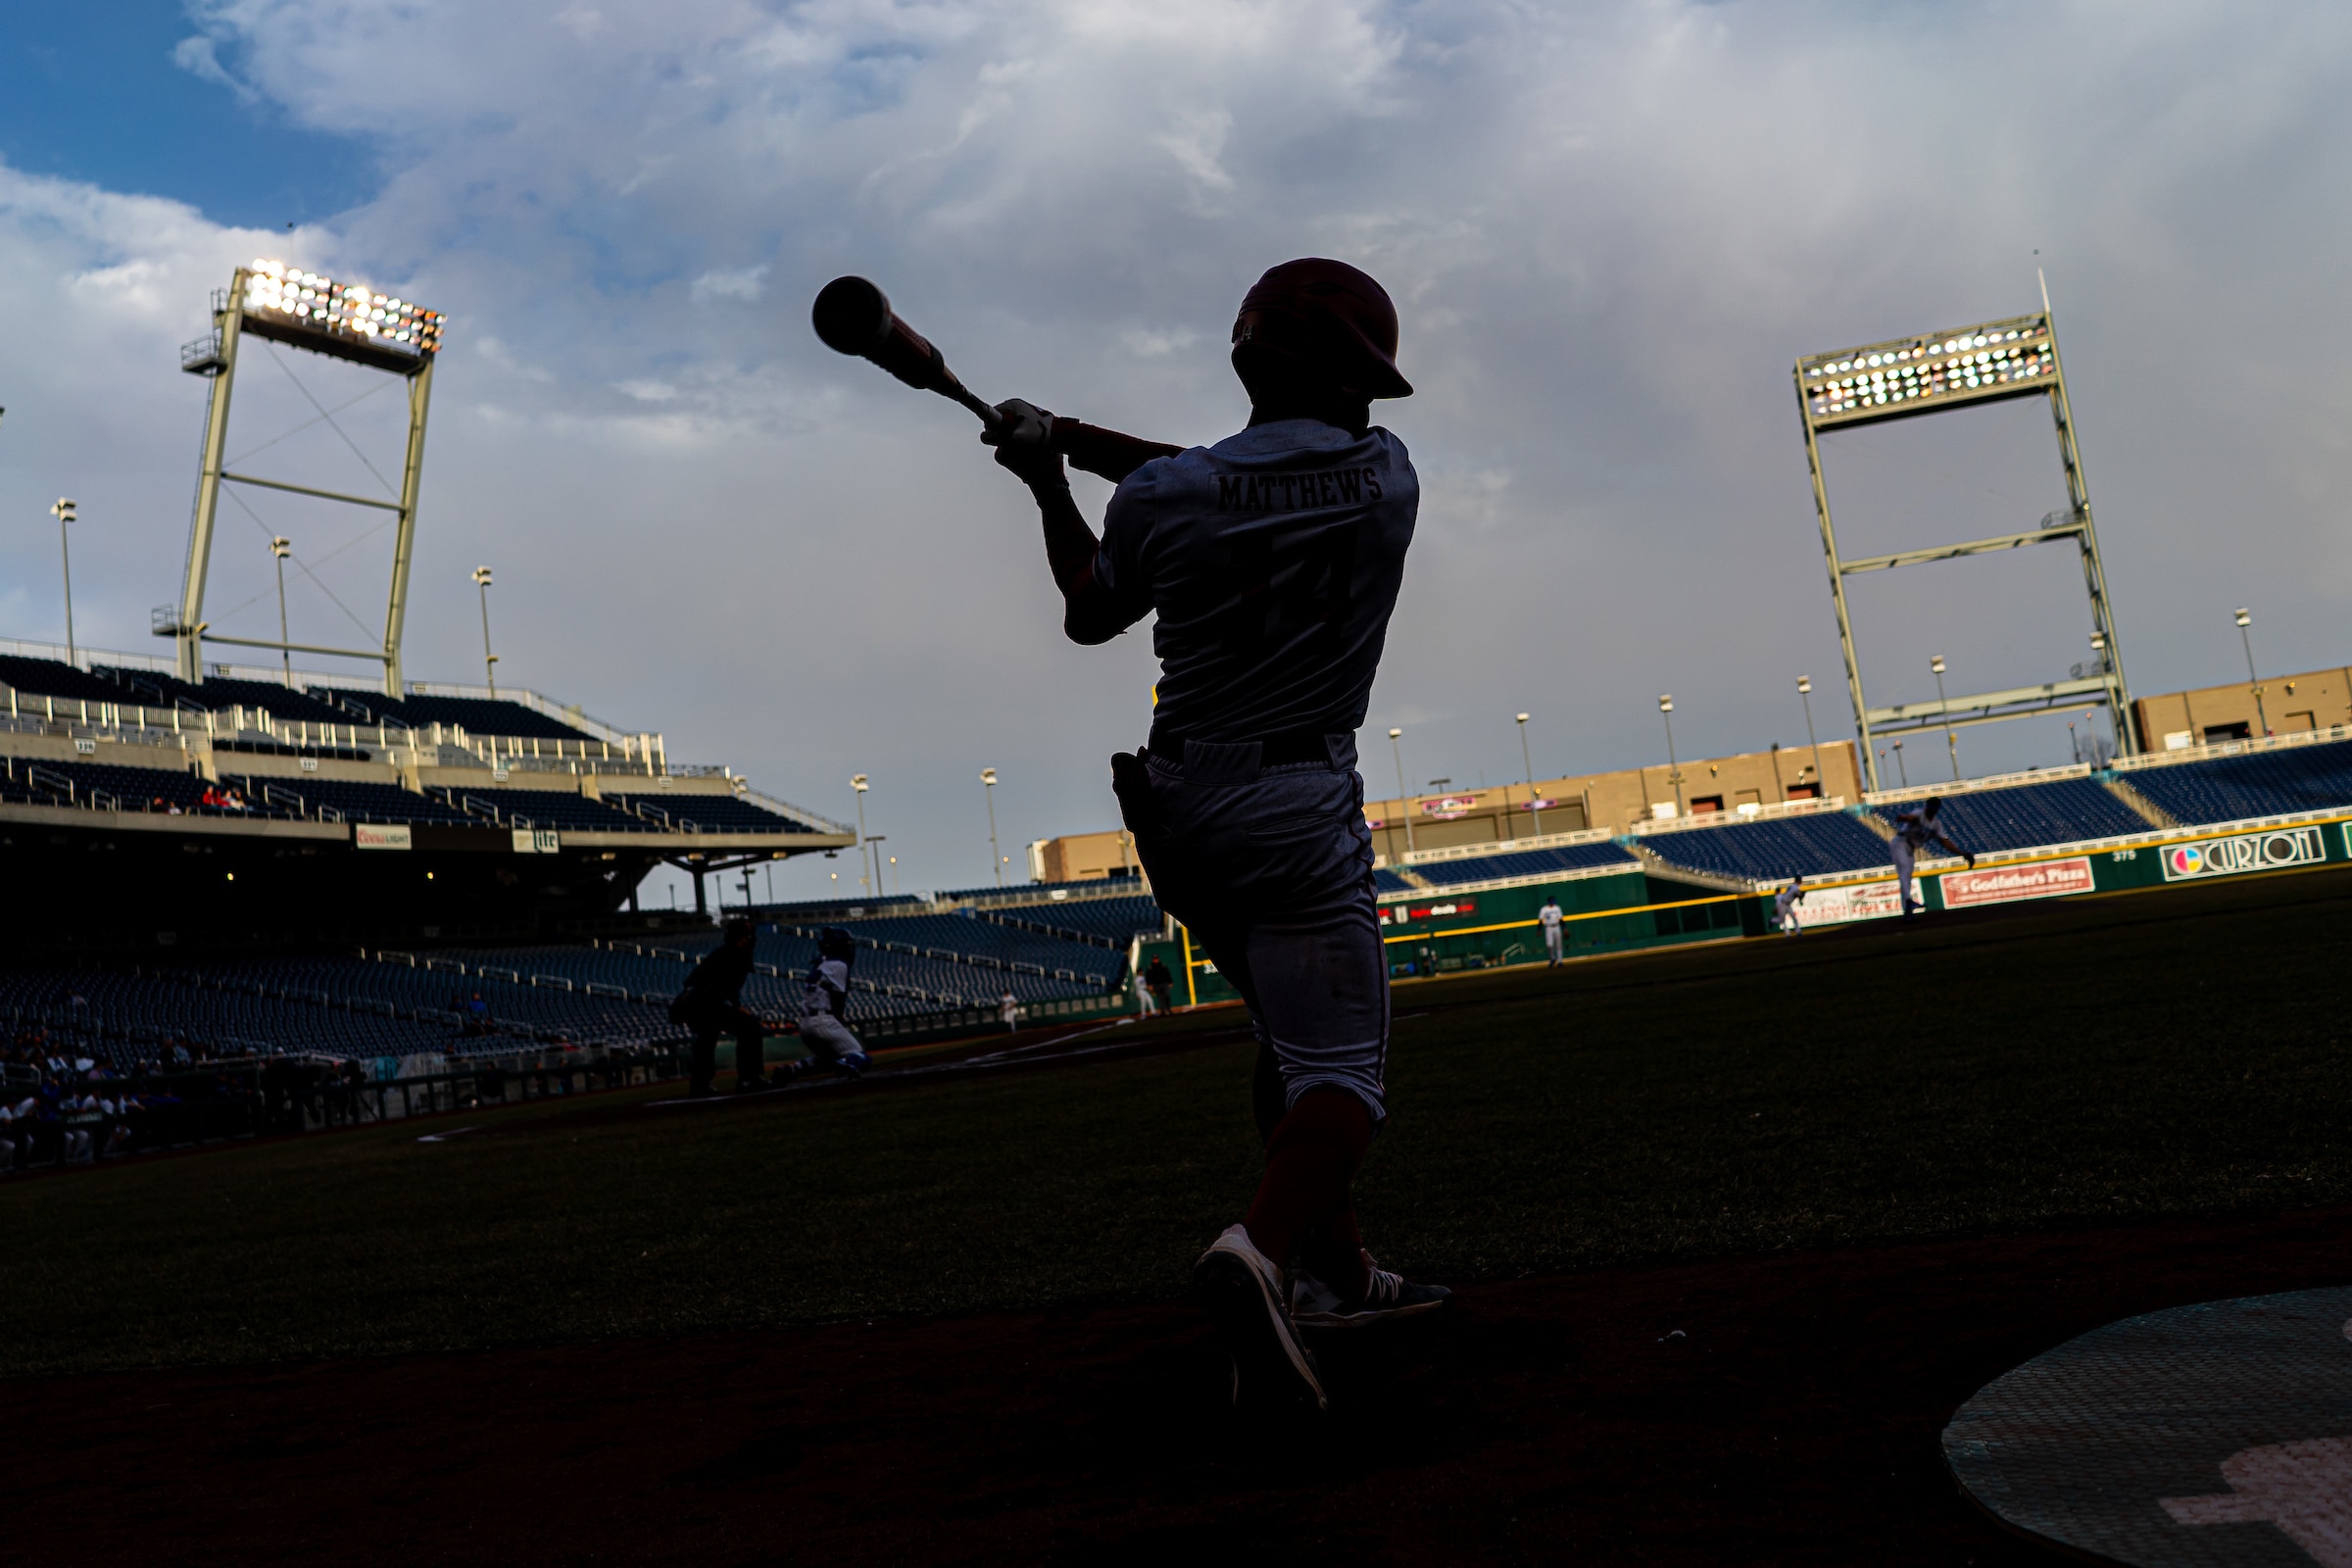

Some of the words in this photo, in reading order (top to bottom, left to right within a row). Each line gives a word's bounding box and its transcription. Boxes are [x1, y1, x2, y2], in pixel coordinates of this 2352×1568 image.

[1219, 467, 1382, 511] MATTHEWS
[2205, 829, 2314, 871] CURZON
[1970, 871, 2045, 893] Godfather's
[2046, 868, 2086, 883] Pizza
